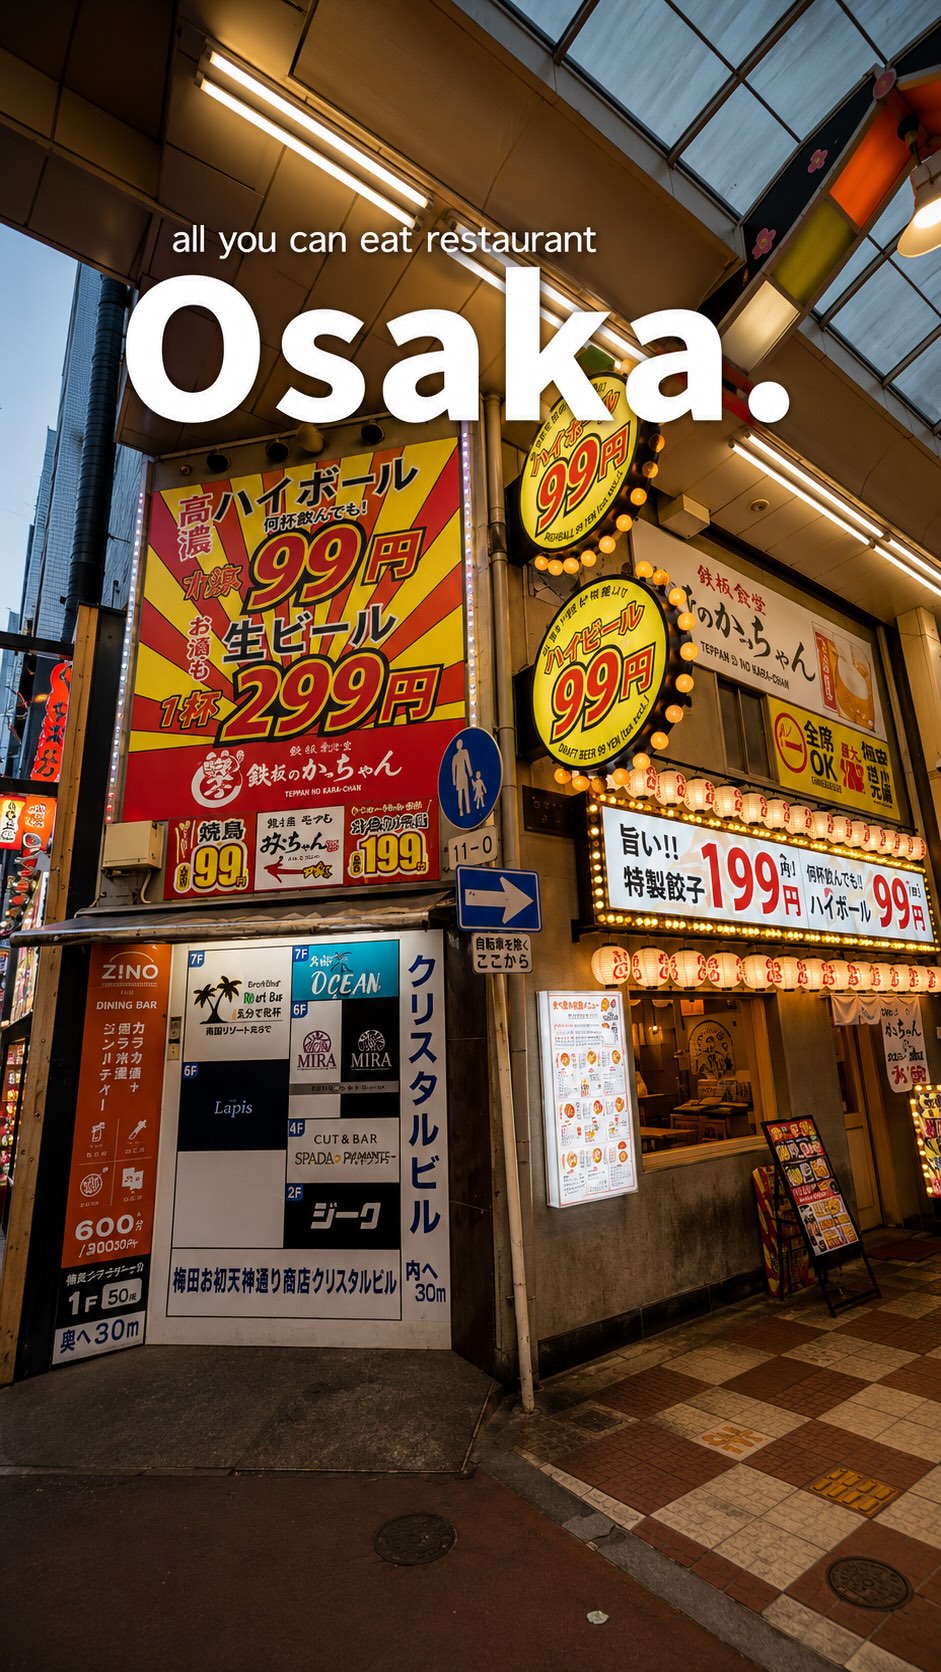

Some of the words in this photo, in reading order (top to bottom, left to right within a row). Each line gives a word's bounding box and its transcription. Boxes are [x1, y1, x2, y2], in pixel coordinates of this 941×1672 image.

[213, 457, 419, 523] ハイボール
[535, 421, 631, 538] 99円
[242, 519, 426, 615] 99円
[221, 603, 399, 665] 生ビール
[544, 600, 646, 675] ハイビール
[214, 647, 445, 747] 299円
[549, 641, 657, 745] 99円
[160, 689, 221, 730] 1杯
[246, 750, 403, 788] 鉄板のかっちゃん
[810, 749, 838, 782] OK
[453, 835, 493, 862] 11-0
[623, 865, 706, 905] 特製餃子
[810, 895, 872, 923] ハイボール
[872, 873, 926, 932] 99円
[191, 953, 203, 964] 7F
[295, 949, 308, 960] 7F
[476, 953, 530, 970] ここから
[310, 970, 381, 996] OCEAN
[96, 1001, 133, 1010] DINING
[136, 1000, 158, 1010] BAR
[293, 1004, 307, 1015] 6F
[184, 1065, 197, 1077] 6F
[297, 1053, 337, 1068] MIRA
[350, 1052, 393, 1068] MIRA
[408, 954, 441, 1234] クリスタルビル
[214, 1100, 253, 1119] Lapis
[289, 1122, 303, 1134] 4F
[314, 1134, 339, 1145] CUT
[341, 1134, 350, 1144] &
[353, 1134, 378, 1144] BAR
[294, 1151, 335, 1165] SPADA
[288, 1186, 301, 1199] 2F
[75, 1214, 135, 1241] 600
[310, 1201, 381, 1230] ジーク
[406, 1259, 439, 1281] 内へ
[69, 1290, 98, 1315] 1F
[415, 1283, 446, 1303] 30m
[60, 1318, 140, 1354] 奥へ30m
